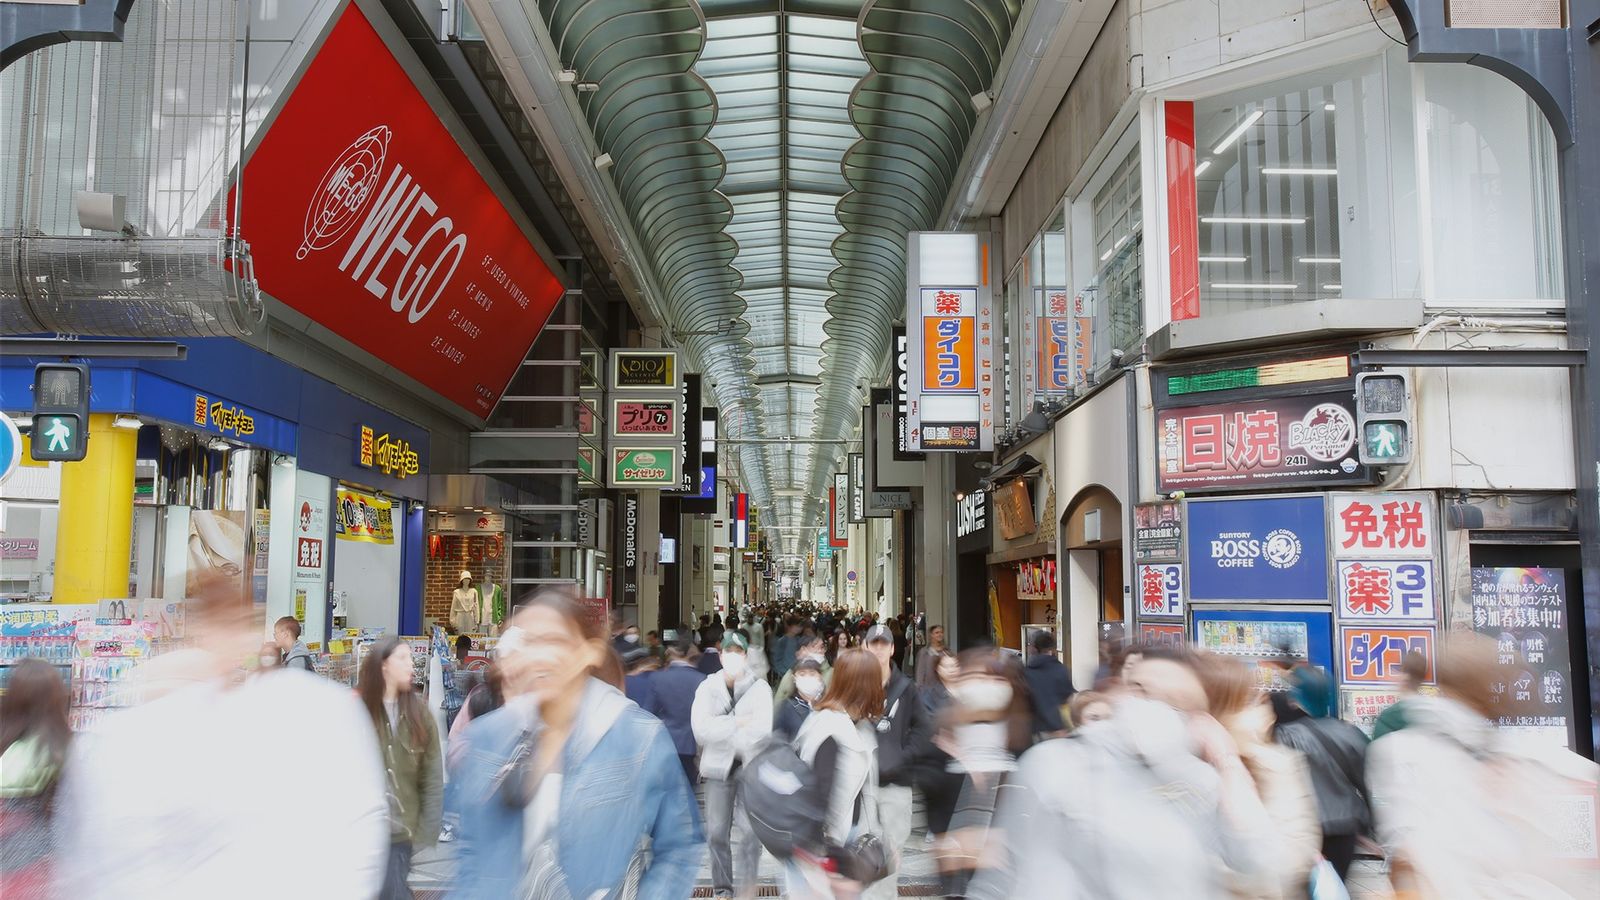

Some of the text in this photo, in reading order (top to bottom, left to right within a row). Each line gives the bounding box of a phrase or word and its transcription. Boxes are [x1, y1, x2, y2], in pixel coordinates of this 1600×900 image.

[327, 164, 370, 212] WEGO
[338, 163, 467, 324] WEGO
[934, 290, 962, 315] 薬
[937, 319, 961, 388] ダイコク
[981, 359, 991, 429] ヒロタビル
[195, 395, 254, 437] 薬 マツモトキヨシ
[623, 409, 666, 425] プリ 7F
[922, 426, 977, 439] 個室日焼
[361, 425, 419, 479] 薬 マツモトキヨシ
[1164, 419, 1178, 474] 完全個室
[1182, 409, 1282, 473] 日焼
[1285, 454, 1308, 467] 24h
[623, 468, 665, 479] サイゼリヤ
[626, 499, 637, 567] McDonald's
[957, 493, 975, 538] LUSH
[1339, 501, 1427, 549] 免税
[300, 540, 320, 567] 免税
[1211, 540, 1260, 558] BOSS
[1217, 559, 1254, 567] COFFEE
[1142, 565, 1181, 613] 薬 3F
[1343, 562, 1426, 615] 薬 3F
[1526, 639, 1544, 651] 男性
[1528, 652, 1544, 663] 部門
[1516, 691, 1530, 701] 部門
